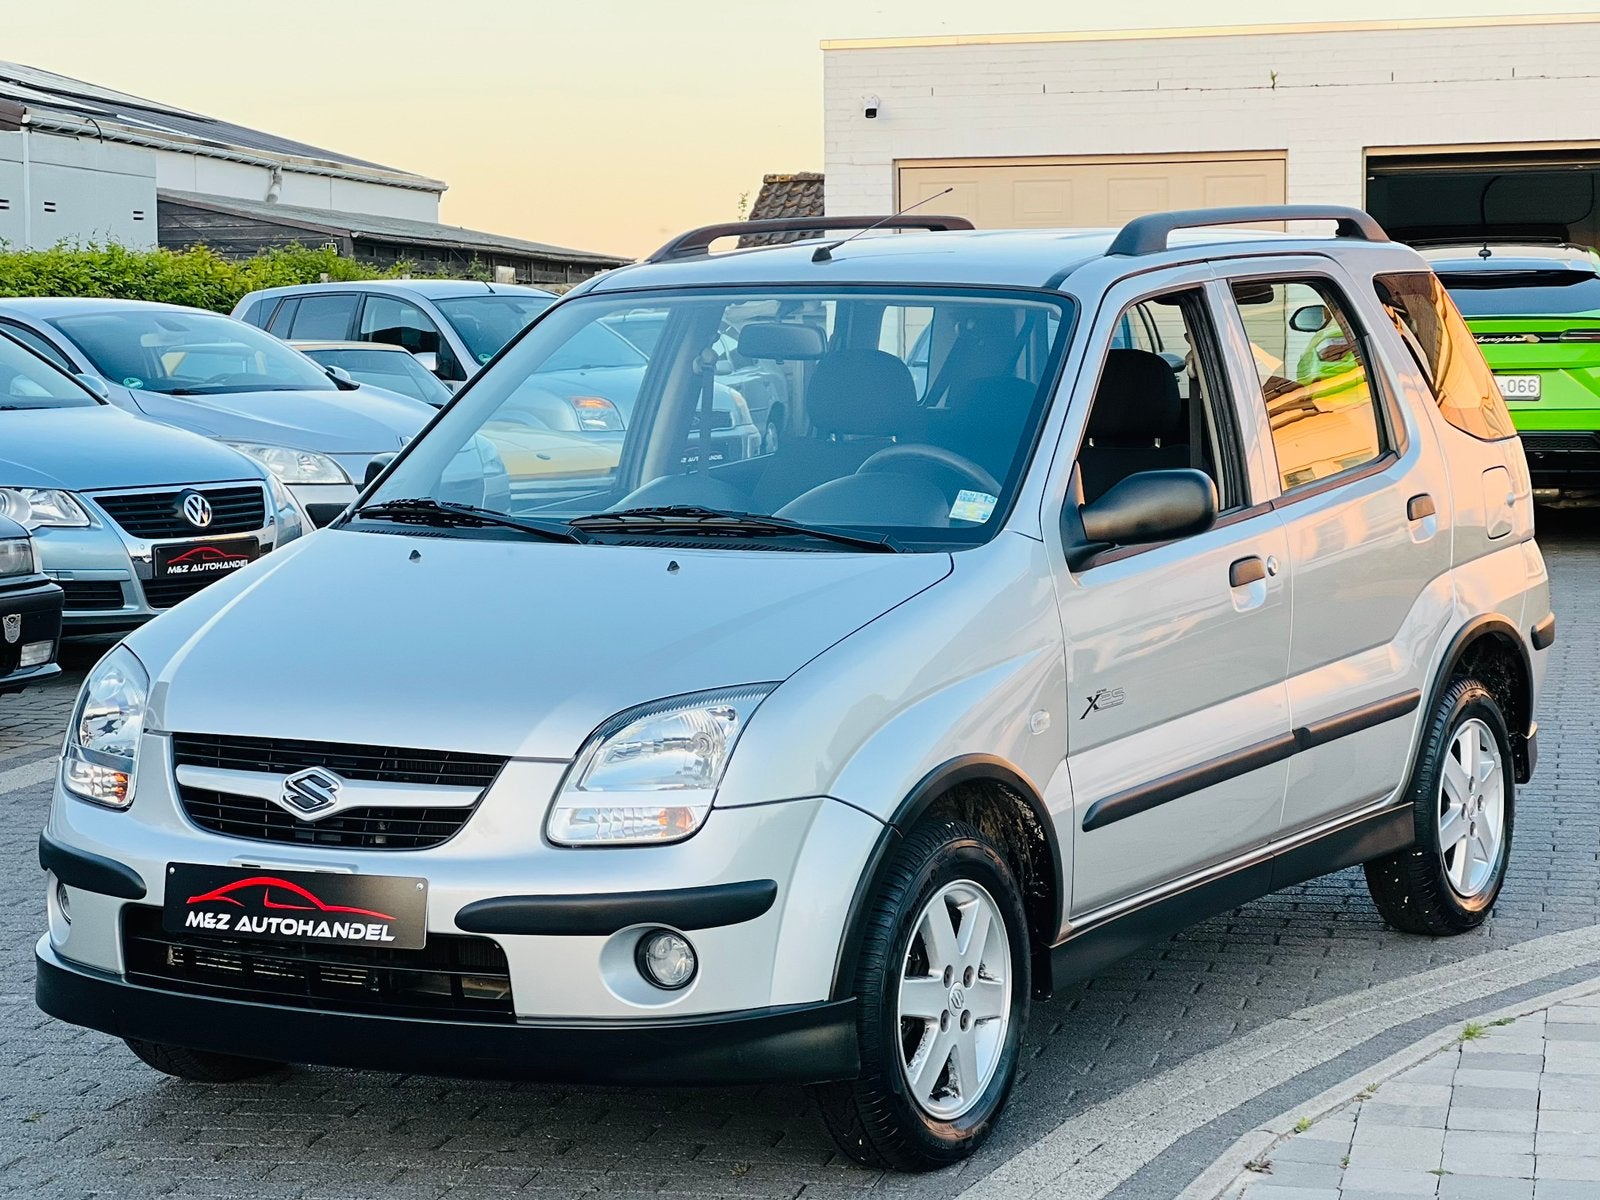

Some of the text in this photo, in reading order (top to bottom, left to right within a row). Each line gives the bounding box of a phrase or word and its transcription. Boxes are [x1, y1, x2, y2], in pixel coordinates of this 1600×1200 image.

[1507, 379, 1537, 393] 066
[167, 564, 189, 574] M&Z
[185, 910, 396, 942] M&Z AUTOHANDEL
